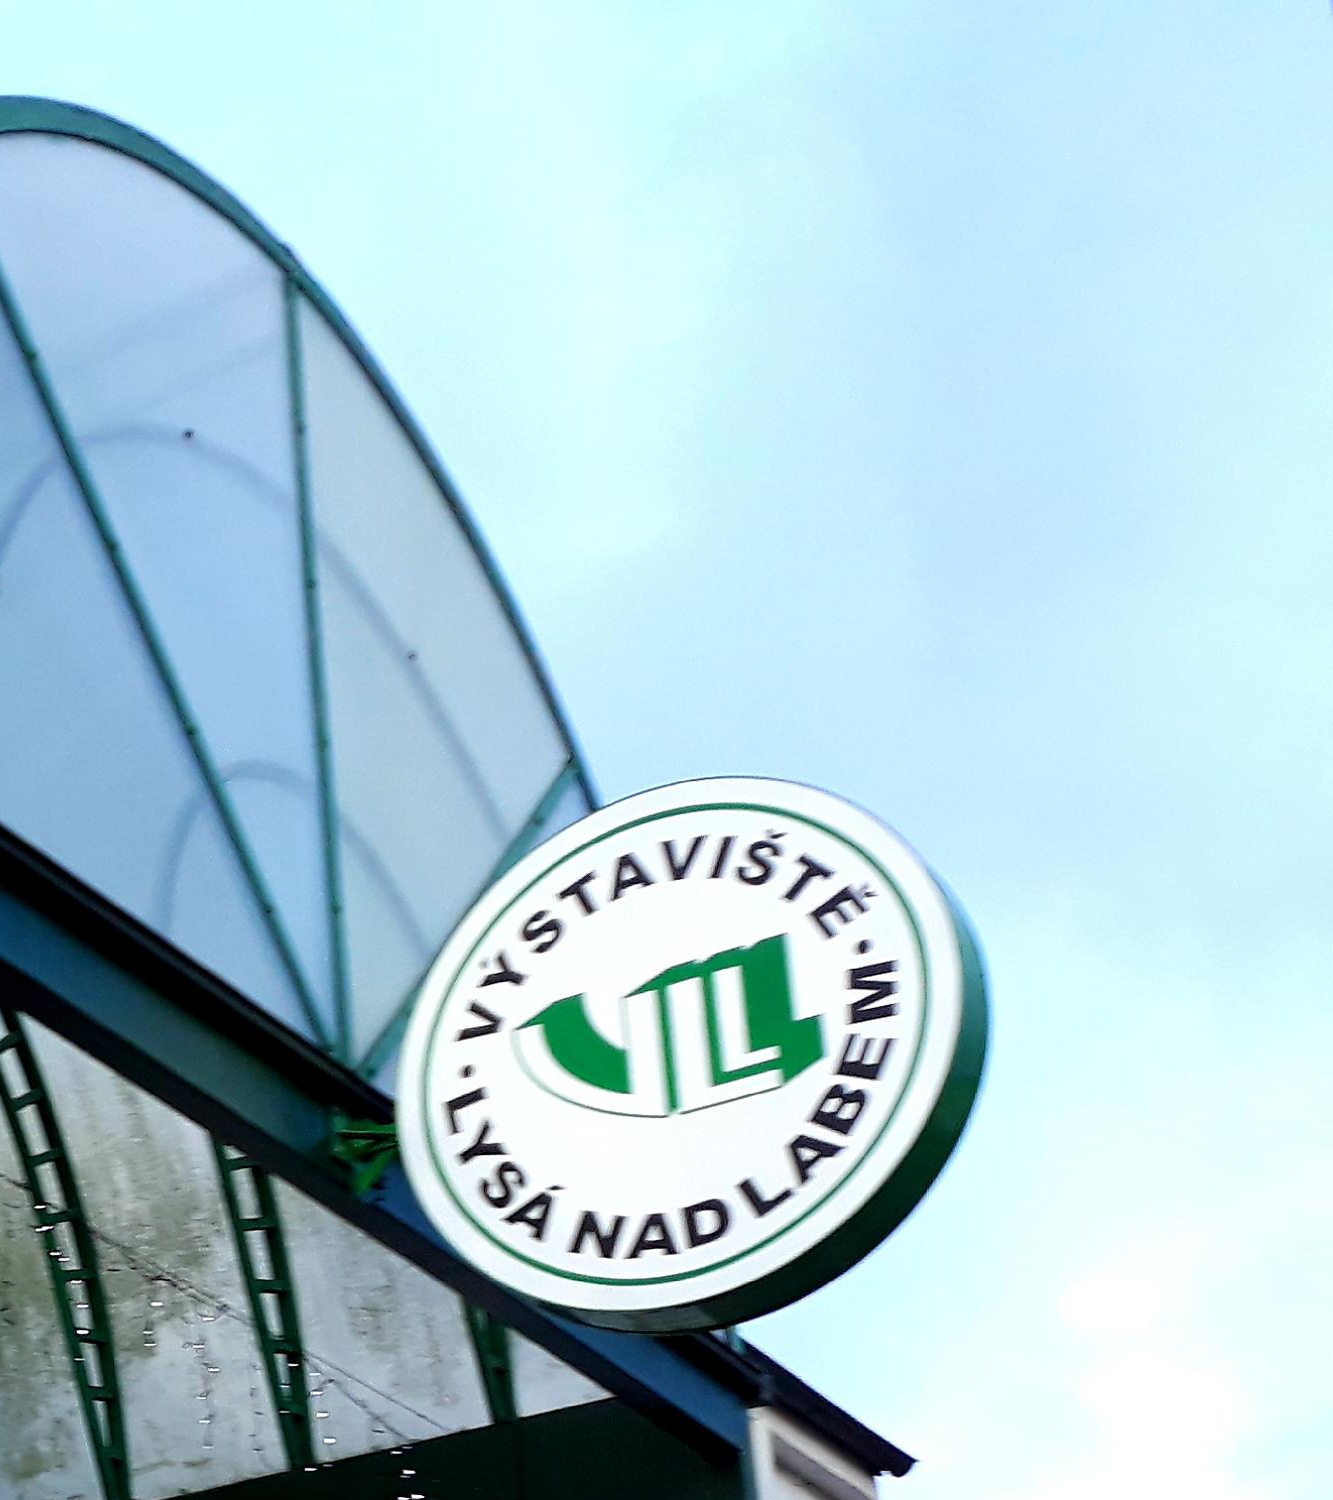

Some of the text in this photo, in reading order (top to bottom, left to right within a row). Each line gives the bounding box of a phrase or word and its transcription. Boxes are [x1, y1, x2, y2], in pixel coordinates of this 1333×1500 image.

[453, 829, 880, 1042] VÝSTAVIŠTĚ
[443, 958, 899, 1260] LYSÁ NAD LABEM
